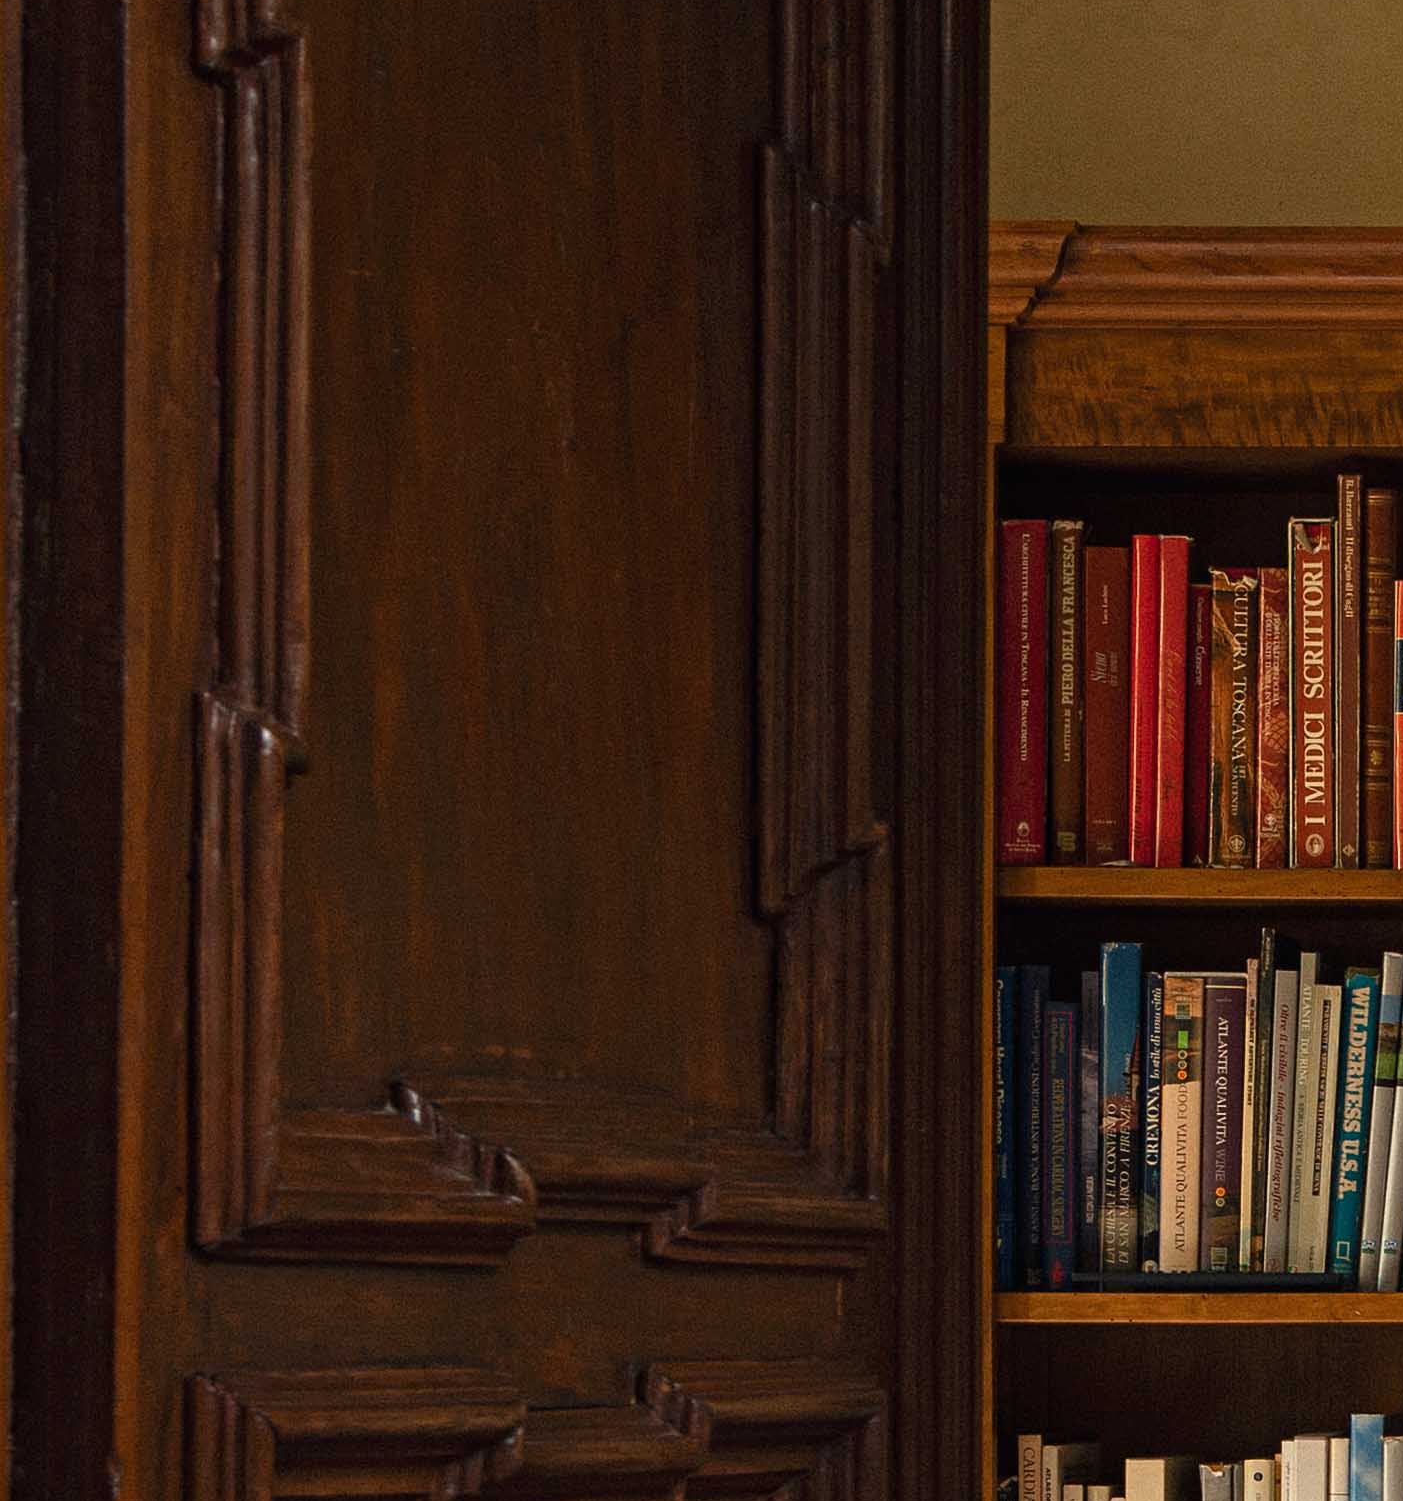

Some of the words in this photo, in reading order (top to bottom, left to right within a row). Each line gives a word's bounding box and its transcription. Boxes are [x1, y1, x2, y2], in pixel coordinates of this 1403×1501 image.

[1061, 535, 1075, 613] FRANCESCA
[1061, 617, 1075, 661] DELLA
[1232, 585, 1249, 671] CULTURA
[1303, 560, 1325, 698] SCRITTORI
[1061, 664, 1075, 704] PIERO
[1231, 676, 1247, 762] TOSCANA
[1305, 712, 1326, 804] MEDICI
[1306, 816, 1325, 826] I
[1216, 1016, 1228, 1074] ATLANTE
[1341, 986, 1371, 1133] WILDERNESS
[1215, 1076, 1228, 1145] QUALIVITA
[1175, 1124, 1187, 1192] QUALIVITA
[1215, 1149, 1226, 1180] WINE
[1336, 1138, 1359, 1200] U.S.A.
[1175, 1195, 1187, 1252] ATLANTE
